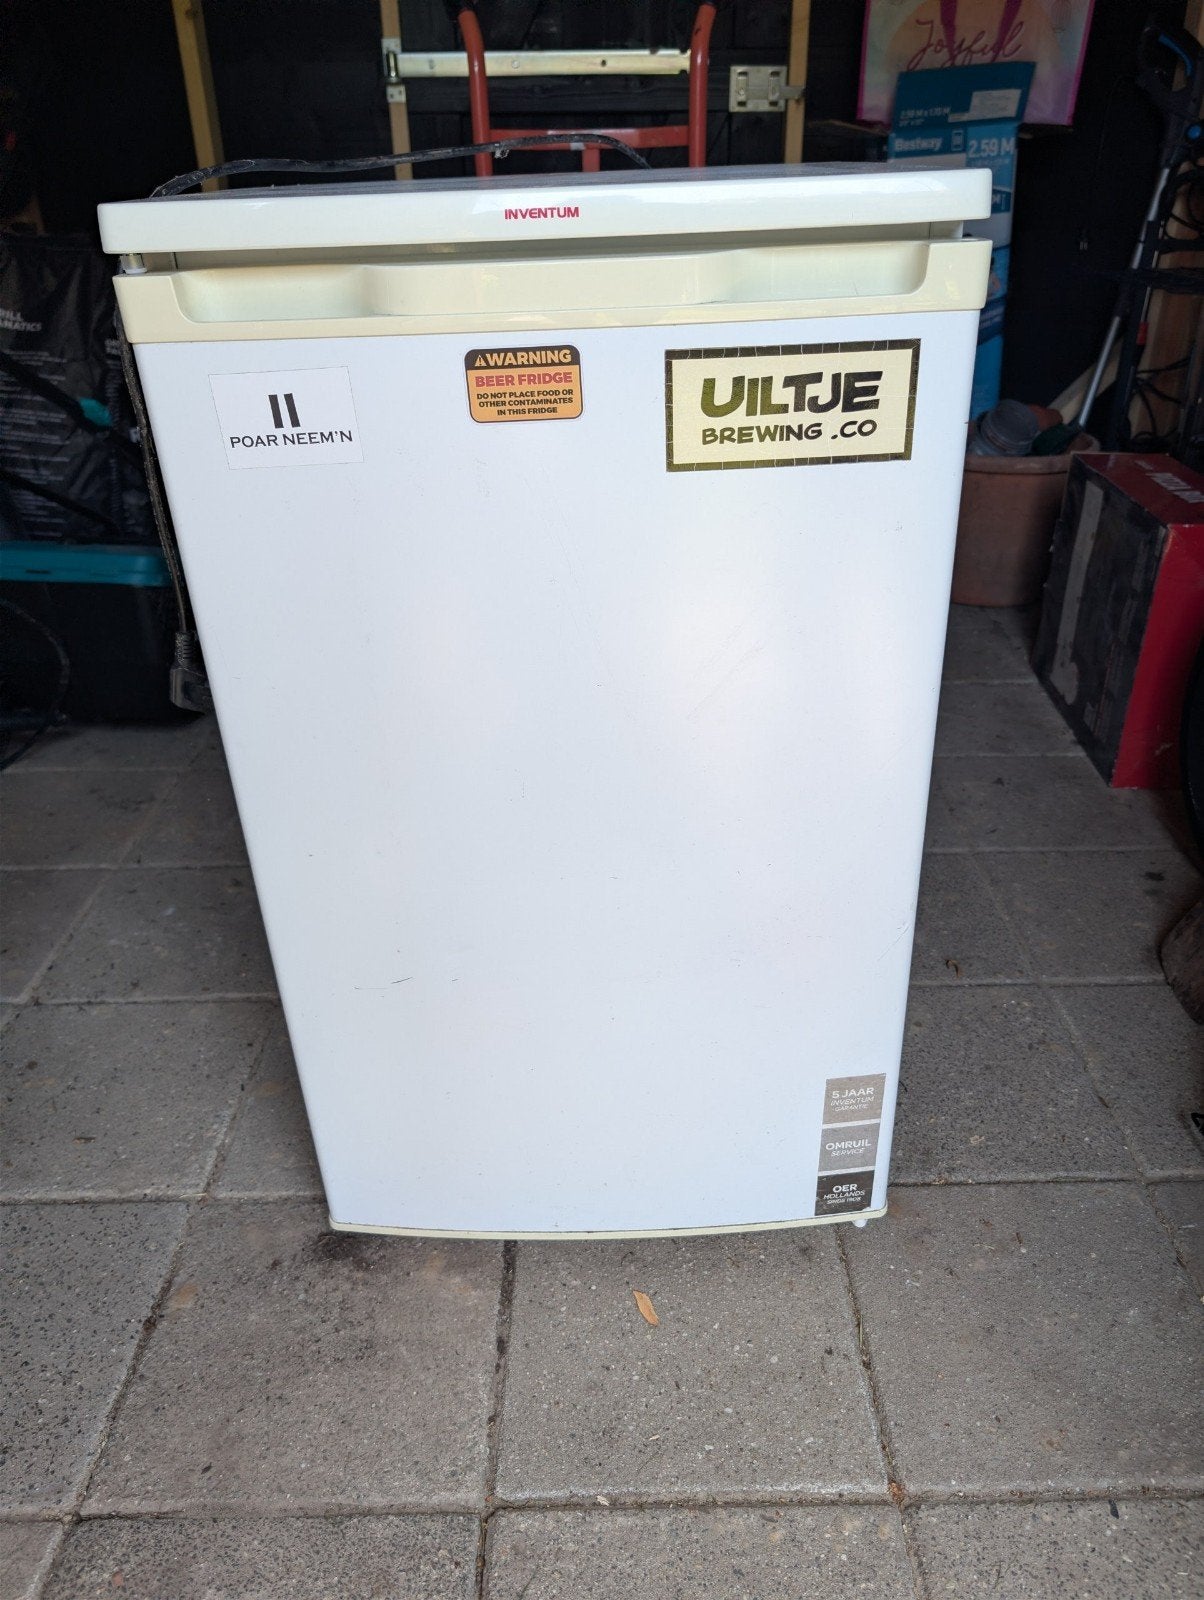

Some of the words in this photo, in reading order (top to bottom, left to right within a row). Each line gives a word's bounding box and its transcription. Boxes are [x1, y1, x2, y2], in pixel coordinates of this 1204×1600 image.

[906, 19, 1024, 71] Joyful
[895, 138, 942, 152] Bestway
[968, 140, 998, 158] 2.59
[1001, 137, 1016, 155] M
[504, 206, 580, 220] INVENTUM
[486, 349, 572, 366] WARNING
[475, 374, 515, 388] BEER
[517, 371, 573, 386] FRIDGE
[490, 391, 507, 399] NOT
[508, 390, 536, 398] PLACE
[537, 389, 560, 397] FOOD
[562, 388, 574, 396] OR
[700, 370, 883, 418] UILTJE
[508, 396, 573, 406] CONTAMINATES
[527, 406, 558, 415] FRIDGE
[230, 434, 279, 448] POAR
[282, 430, 353, 446] NEEM'N
[702, 422, 823, 446] BREWING
[832, 1090, 840, 1099] 5
[842, 1087, 875, 1098] JAAR
[830, 1096, 874, 1107] INVENTUM
[825, 1139, 872, 1151] OMRUIL
[831, 1148, 865, 1157] SERVICE
[832, 1183, 858, 1193] OER
[823, 1190, 866, 1200] HOLLANDS
